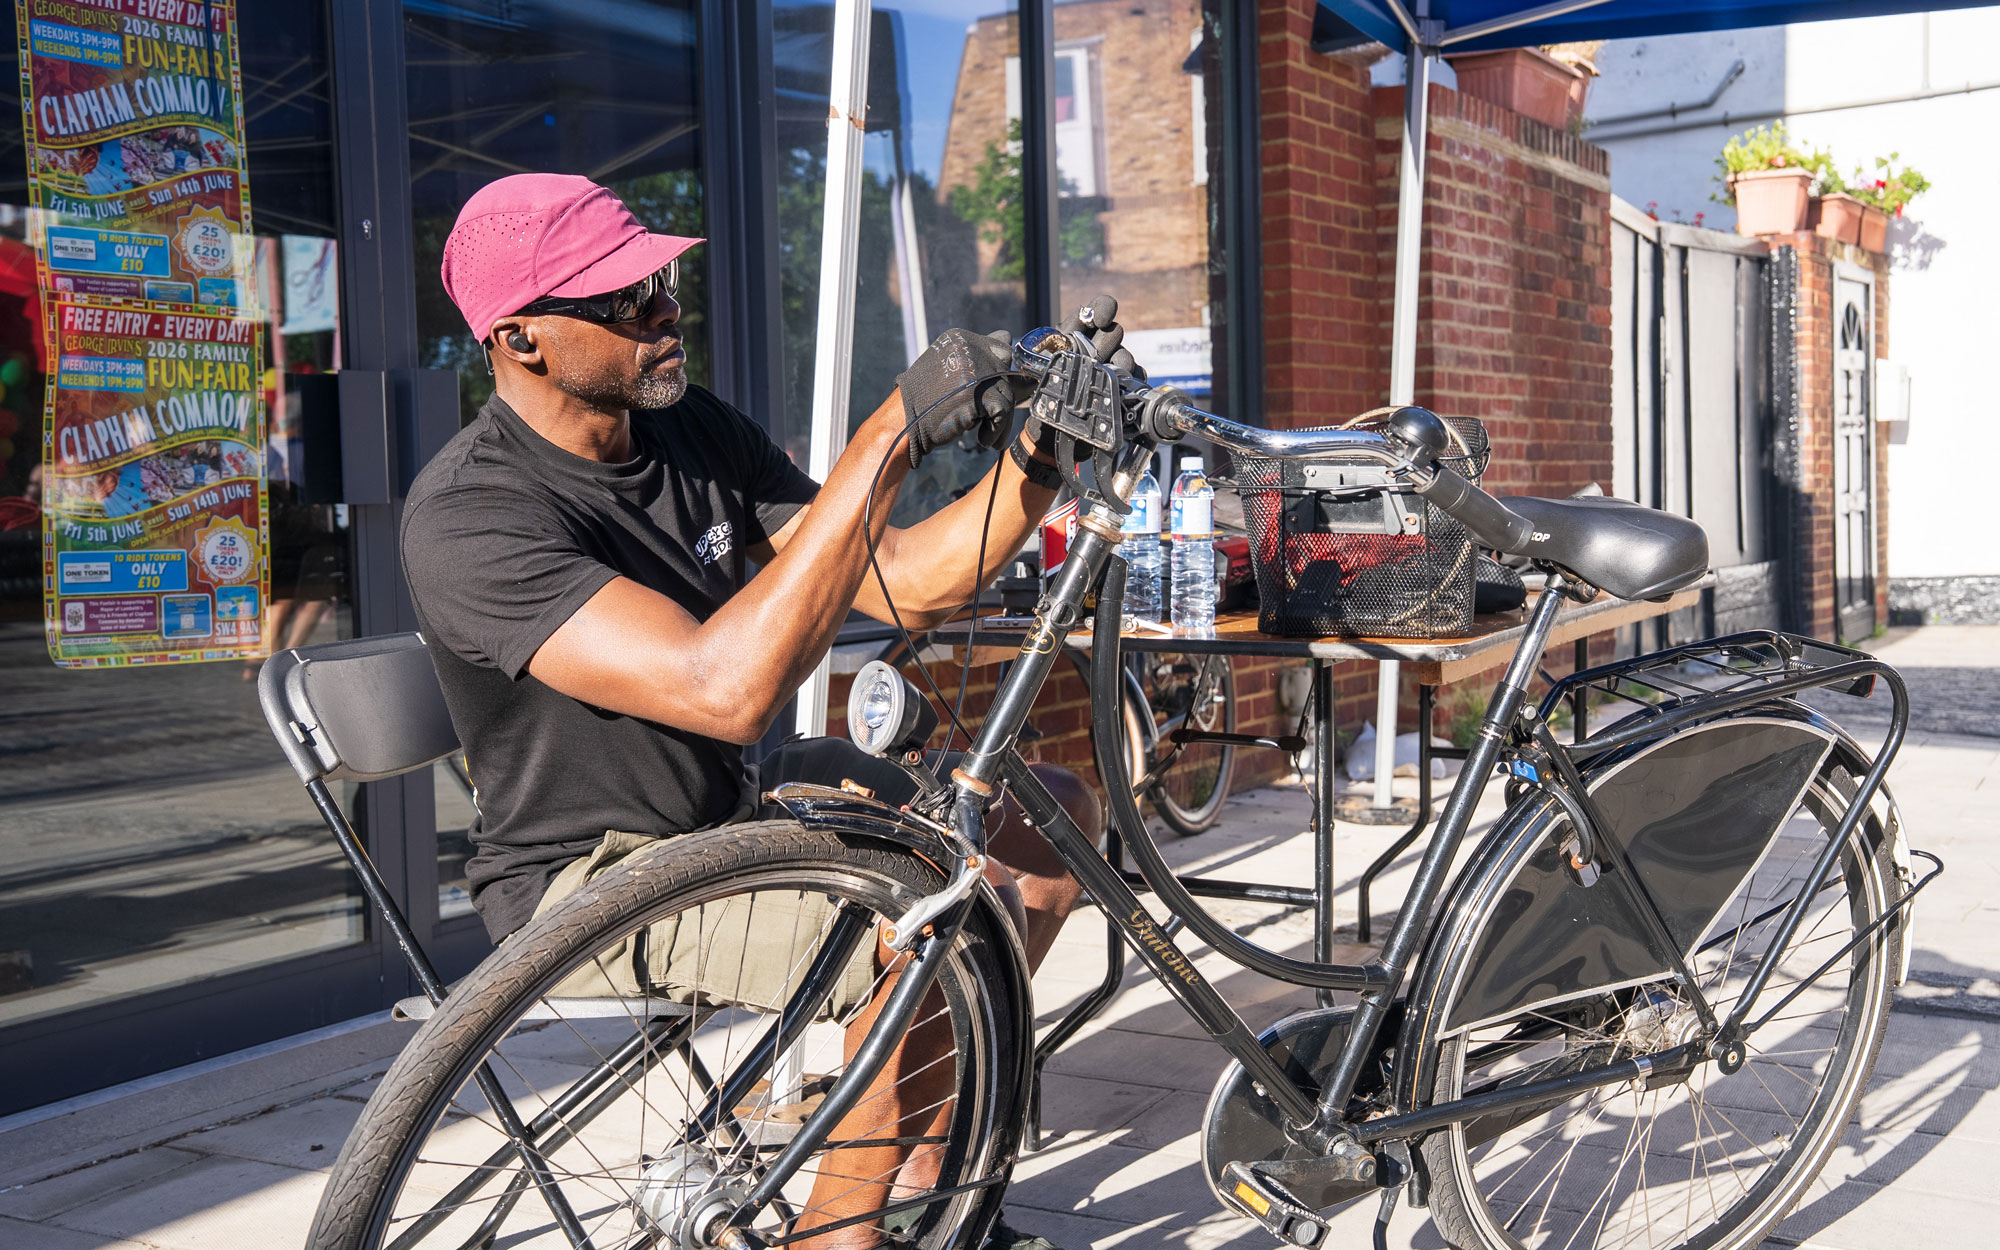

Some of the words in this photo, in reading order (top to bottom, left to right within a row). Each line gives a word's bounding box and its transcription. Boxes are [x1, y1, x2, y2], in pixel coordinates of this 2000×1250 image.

[34, 0, 78, 24] GEORGE
[138, 0, 185, 23] EVERY
[187, 3, 220, 30] DA!
[33, 24, 80, 43] WEEKDAYS
[81, 33, 120, 50] 3PM-9PM
[123, 17, 160, 40] 2026
[166, 26, 221, 50] FAMIY
[34, 39, 82, 58] WEEKENDS
[84, 48, 120, 65] 1PM-9PM
[125, 34, 225, 80] FUN-FAIR
[40, 83, 136, 135] CLAPHAM
[50, 195, 66, 214] Fri
[72, 201, 91, 218] 5th
[95, 199, 126, 221] JUNE
[148, 188, 173, 205] Sun
[174, 178, 201, 197] 14th
[203, 175, 233, 193] JUNE
[98, 233, 108, 242] 10
[109, 234, 129, 244] RIDE
[132, 235, 165, 247] TOKENS
[201, 225, 219, 238] 25
[54, 244, 69, 252] ONE
[70, 246, 94, 254] TOKEN
[115, 244, 150, 259] ONLY
[193, 244, 226, 259] £20!
[121, 258, 144, 272] £10
[64, 306, 103, 333] FREE
[104, 310, 151, 336] ENTRY
[164, 315, 216, 340] EVERY
[217, 319, 250, 343] DAY!
[65, 335, 105, 355] GEORGE
[148, 341, 187, 358] 2026
[194, 344, 249, 363] FAMILY
[62, 358, 104, 372] WEEKDAYS
[106, 360, 143, 375] 3PM-9PM
[149, 358, 251, 392] FUN-FAIR
[61, 374, 105, 387] WEEKENDS
[107, 375, 143, 389] 1PM-9PM
[60, 405, 157, 465] CLAPHAM
[156, 392, 251, 436] COMMON
[64, 521, 82, 539] Fri
[87, 526, 107, 542] 5th
[112, 519, 143, 543] JUNE
[168, 503, 192, 521] Sun
[193, 489, 220, 511] 14th
[221, 484, 252, 503] JUNE
[219, 536, 236, 547] 25
[114, 554, 124, 563] 10
[126, 553, 146, 562] RIDE
[149, 553, 182, 562] TOKENS
[211, 555, 243, 567] £20!
[131, 562, 167, 575] ONLY
[137, 575, 161, 588] £10
[215, 621, 237, 636] SW4
[239, 620, 259, 634] 9AN
